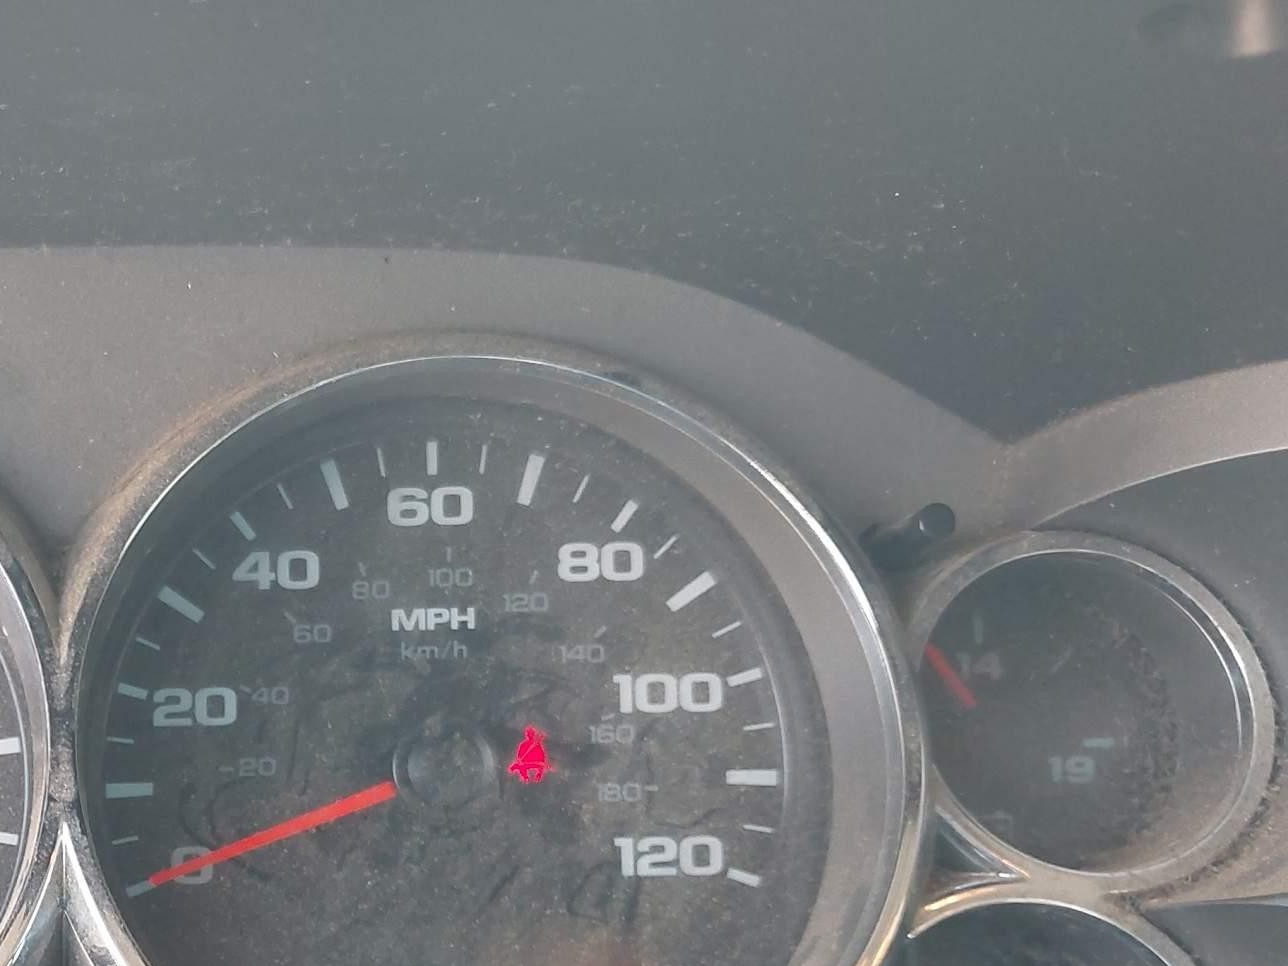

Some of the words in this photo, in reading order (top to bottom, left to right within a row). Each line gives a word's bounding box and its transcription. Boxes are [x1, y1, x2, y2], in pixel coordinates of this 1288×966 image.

[387, 486, 473, 527] 60
[232, 550, 320, 590] 40
[557, 542, 644, 582] 80
[428, 567, 473, 589] 100
[352, 580, 390, 601] 80
[504, 593, 549, 614] 120
[391, 608, 475, 630] MPH
[294, 624, 332, 644] 60
[400, 640, 468, 662] km/h
[559, 643, 605, 664] 140
[251, 685, 289, 706] 40
[613, 672, 723, 713] 100
[152, 687, 238, 727] 20
[589, 725, 634, 745] 160
[238, 757, 277, 777] 20
[1049, 756, 1096, 784] 19
[597, 782, 642, 803] 180
[170, 846, 213, 885] 0
[613, 836, 723, 877] 120
